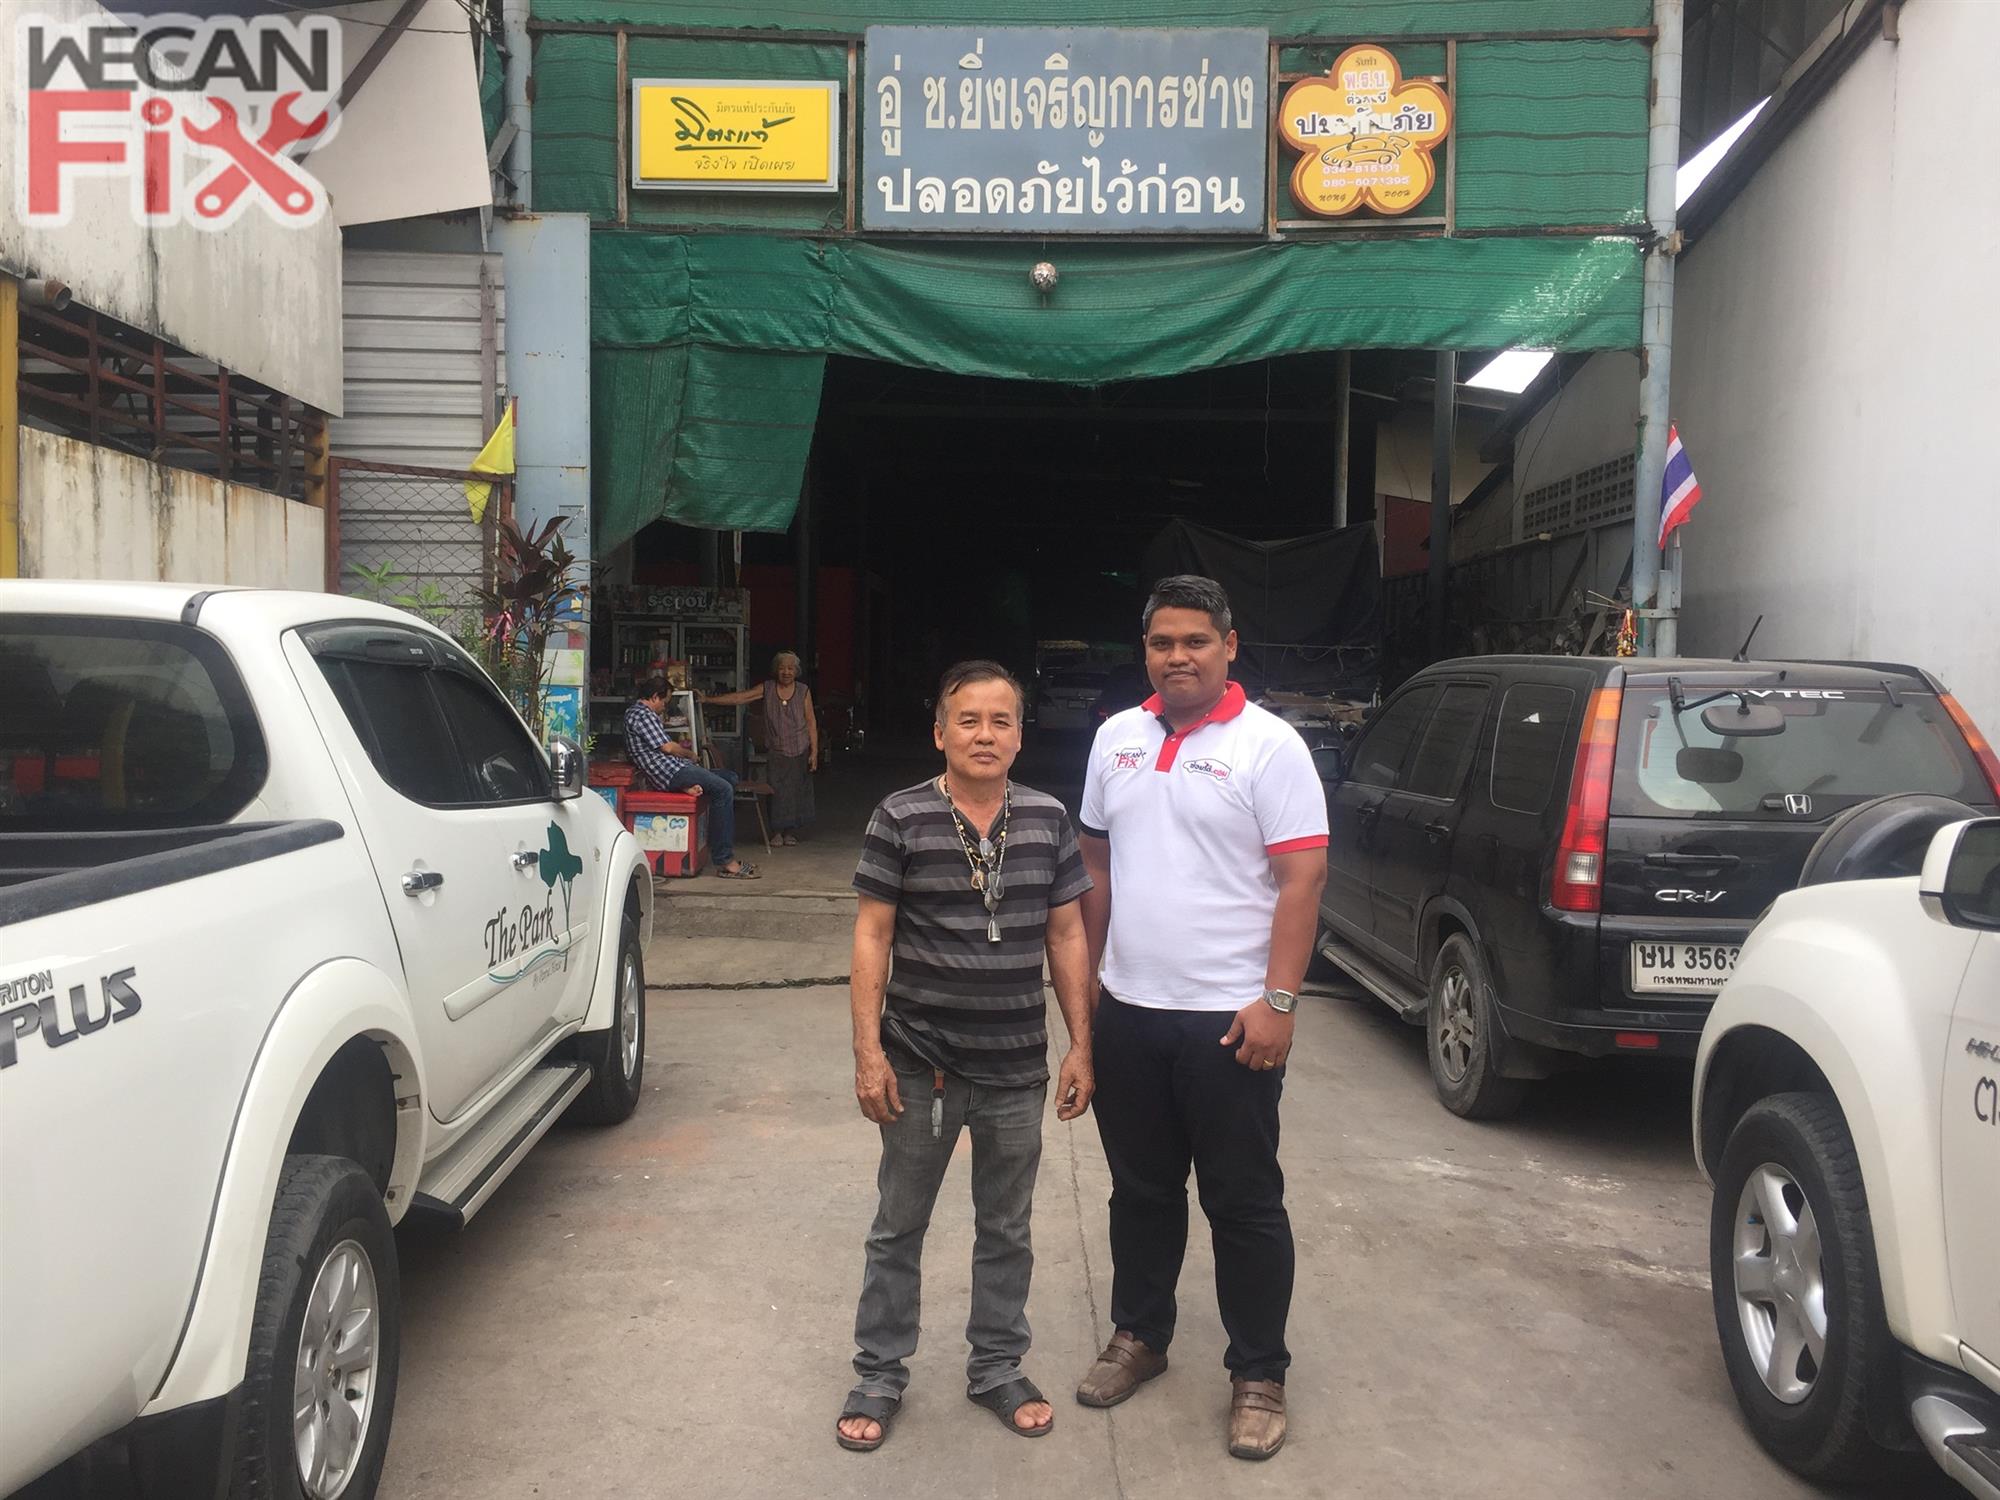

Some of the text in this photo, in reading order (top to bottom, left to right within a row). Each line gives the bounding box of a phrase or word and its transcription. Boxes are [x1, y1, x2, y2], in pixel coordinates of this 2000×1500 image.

[877, 37, 1254, 156] อู่ ช.ยิ่งเจริญการช่าง
[694, 154, 796, 171] จริงใจ เปิดเผย
[876, 156, 1246, 214] ปลอดภัยไว้ก่อน
[484, 888, 560, 970] The Park
[1654, 888, 1728, 904] CR-V
[0, 966, 143, 1071] PLUS
